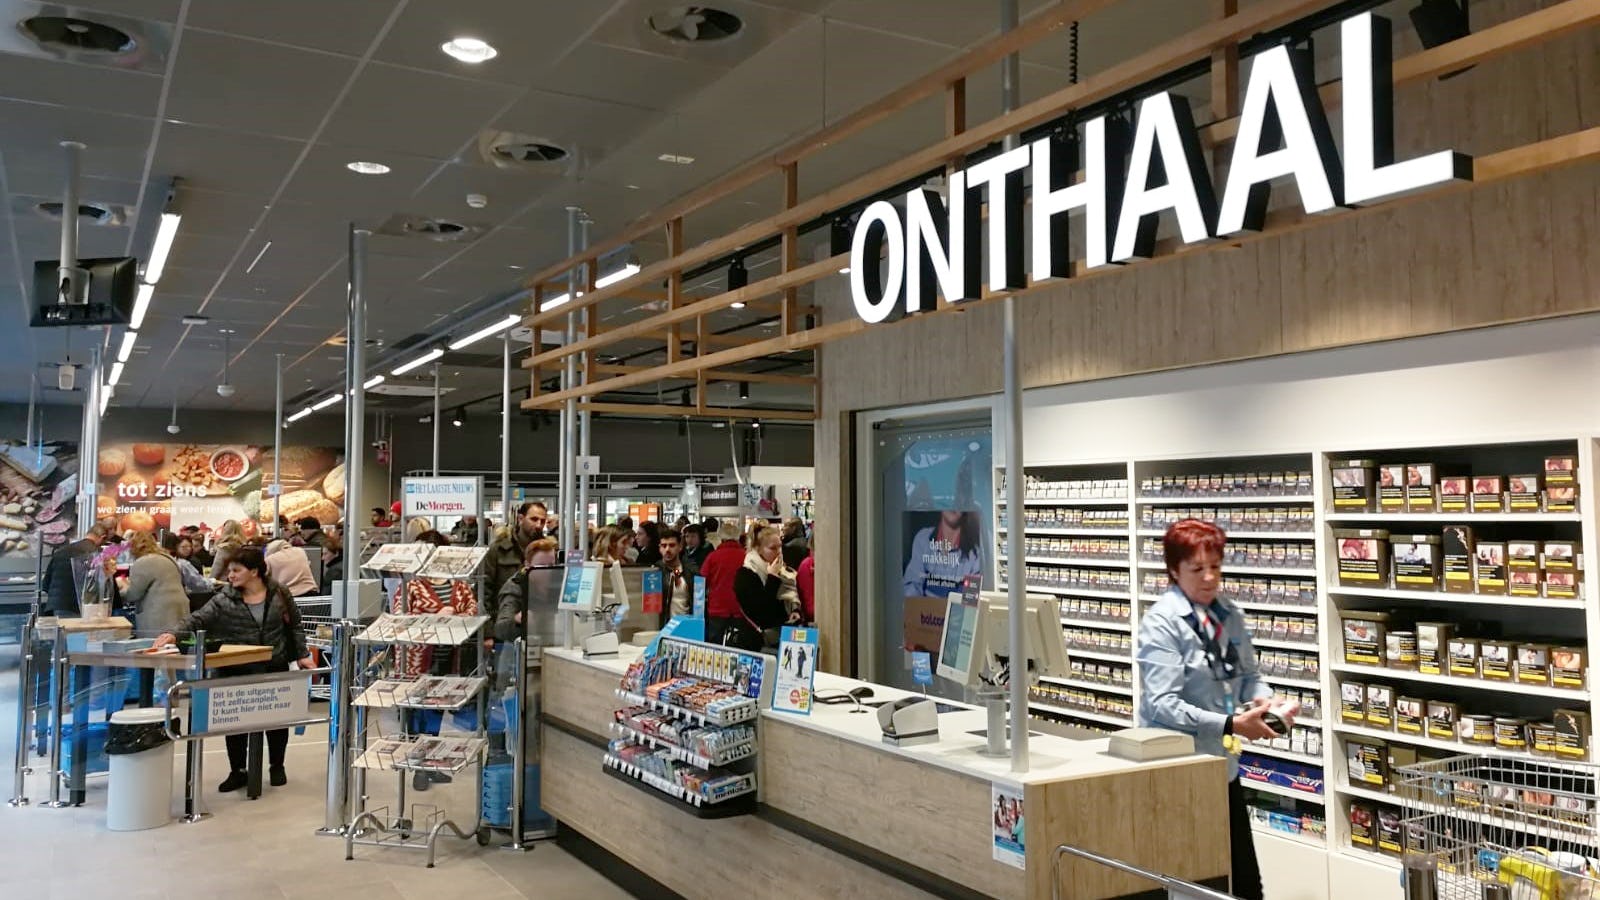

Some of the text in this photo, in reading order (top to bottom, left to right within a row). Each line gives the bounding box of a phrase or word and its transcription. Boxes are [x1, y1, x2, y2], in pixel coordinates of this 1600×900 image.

[850, 11, 1460, 323] ONTHAAL
[117, 482, 207, 497] tot ziens
[97, 506, 112, 514] we
[115, 504, 137, 514] zien
[149, 506, 177, 516] graag
[929, 538, 952, 551] dat is
[922, 552, 960, 567] makkelijk
[226, 690, 233, 698] is
[235, 689, 245, 697] de
[247, 687, 275, 696] uitgang
[277, 685, 291, 693] van
[213, 699, 226, 708] het
[213, 701, 291, 716] U kunt hier niet naar
[212, 716, 241, 725] binnen.
